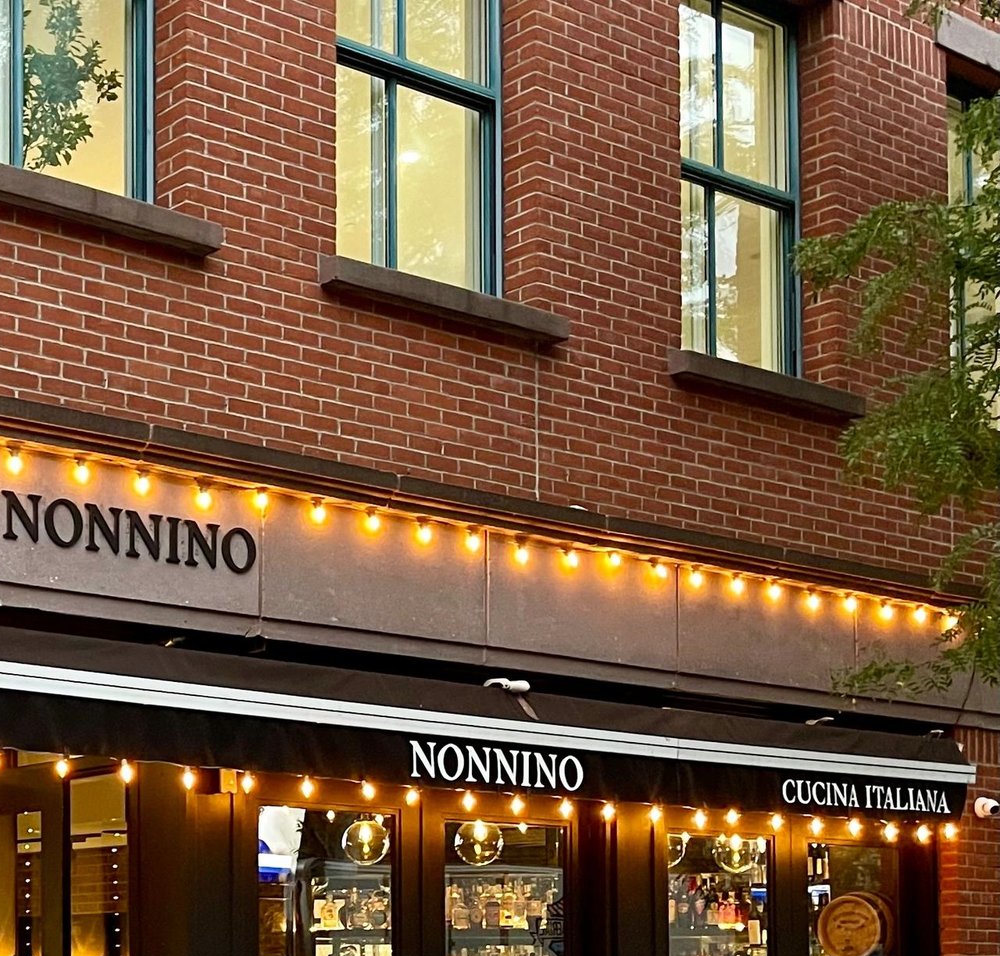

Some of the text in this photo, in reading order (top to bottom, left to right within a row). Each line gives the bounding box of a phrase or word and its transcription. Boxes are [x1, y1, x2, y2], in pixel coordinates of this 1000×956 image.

[1, 489, 256, 574] NONNINO
[409, 740, 584, 791] NONNINO
[782, 779, 951, 814] CUCINA ITALIANA
